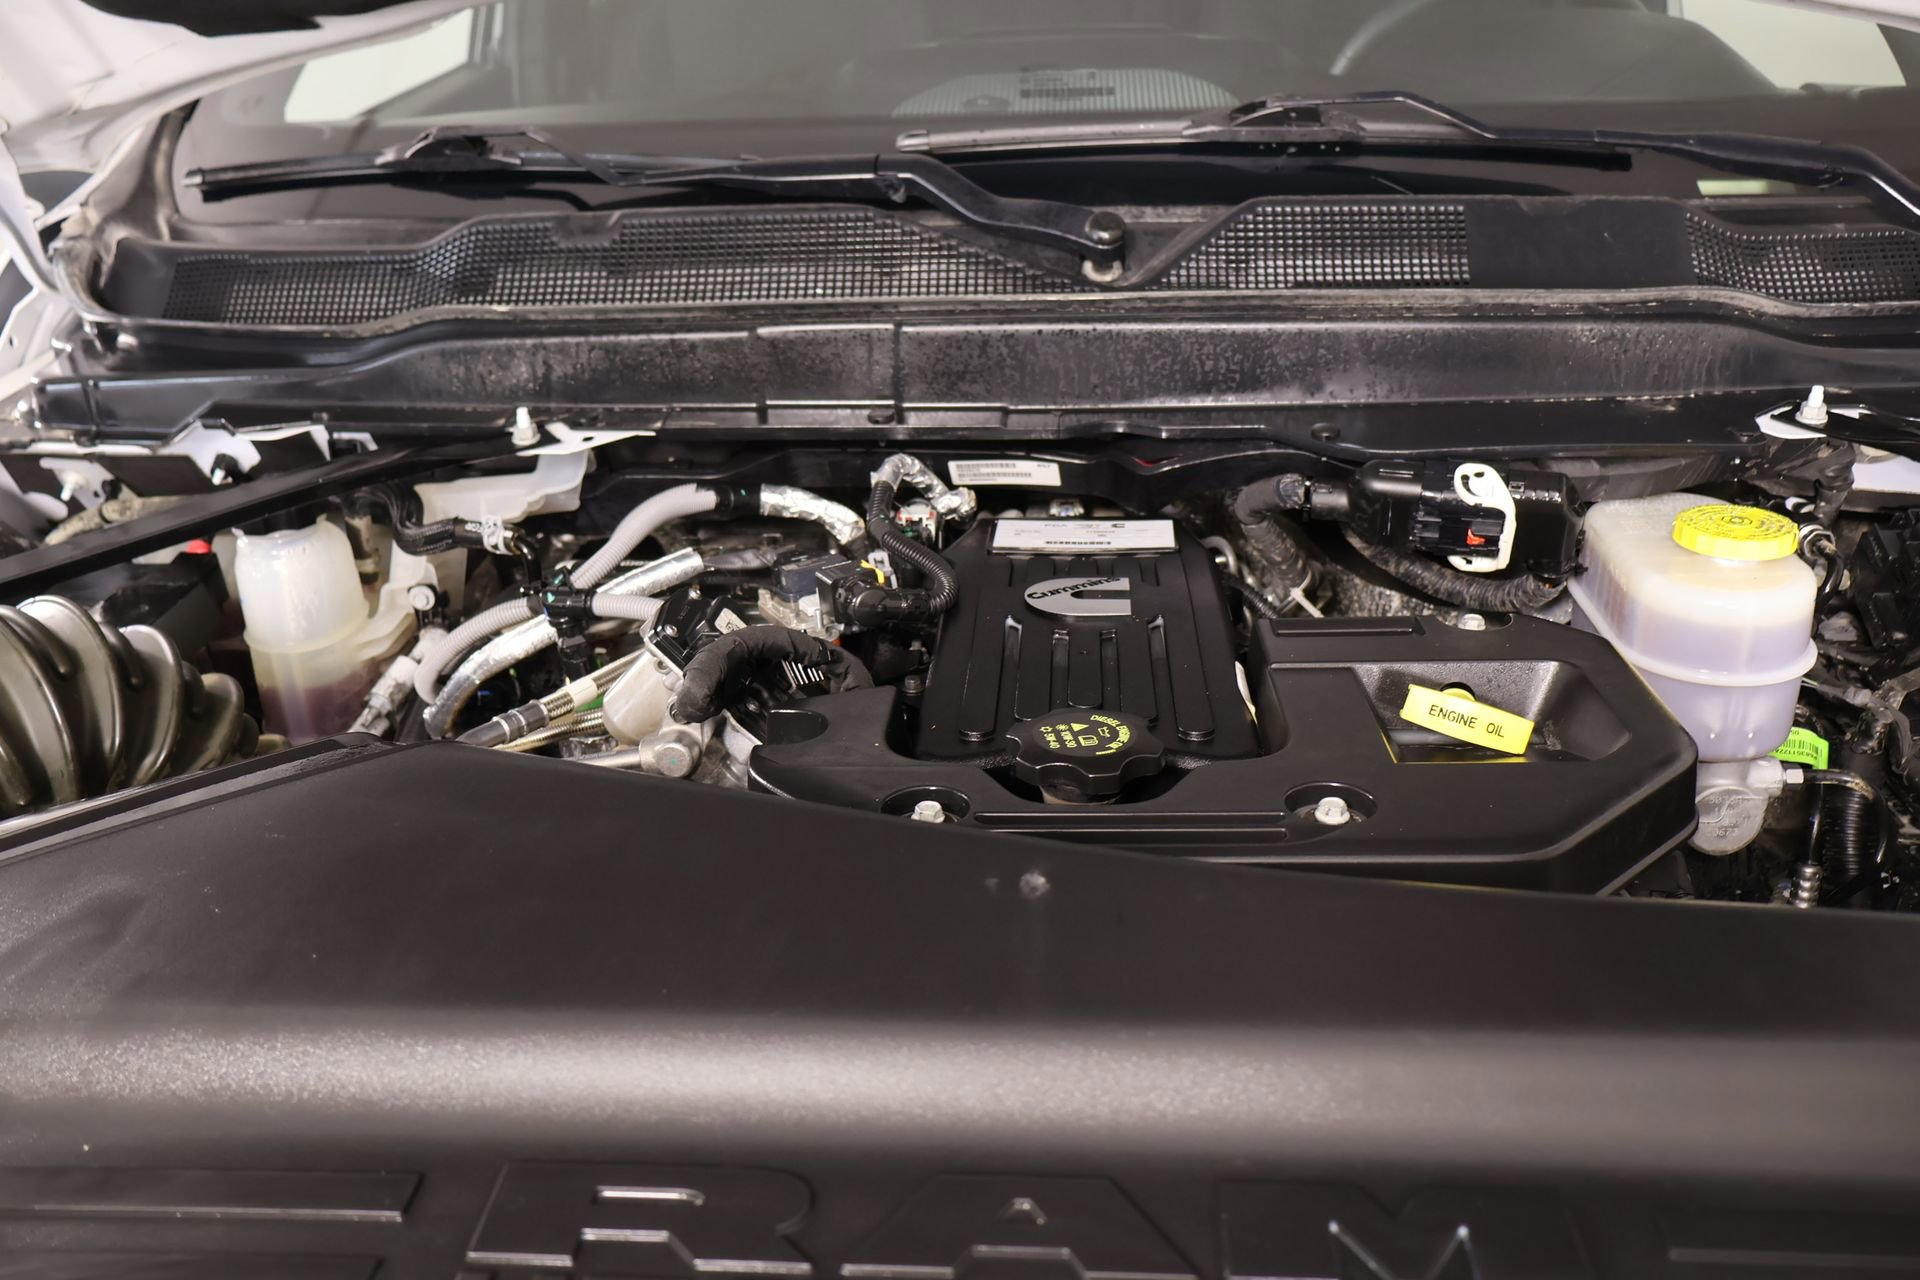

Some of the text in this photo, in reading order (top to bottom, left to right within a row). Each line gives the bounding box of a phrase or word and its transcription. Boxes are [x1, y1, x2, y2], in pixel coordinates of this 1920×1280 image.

[1026, 577, 1121, 600] Cummins
[1090, 714, 1121, 727] DIESEL
[1428, 704, 1505, 738] ENGINE OIL
[466, 1159, 1592, 1280] RAM
